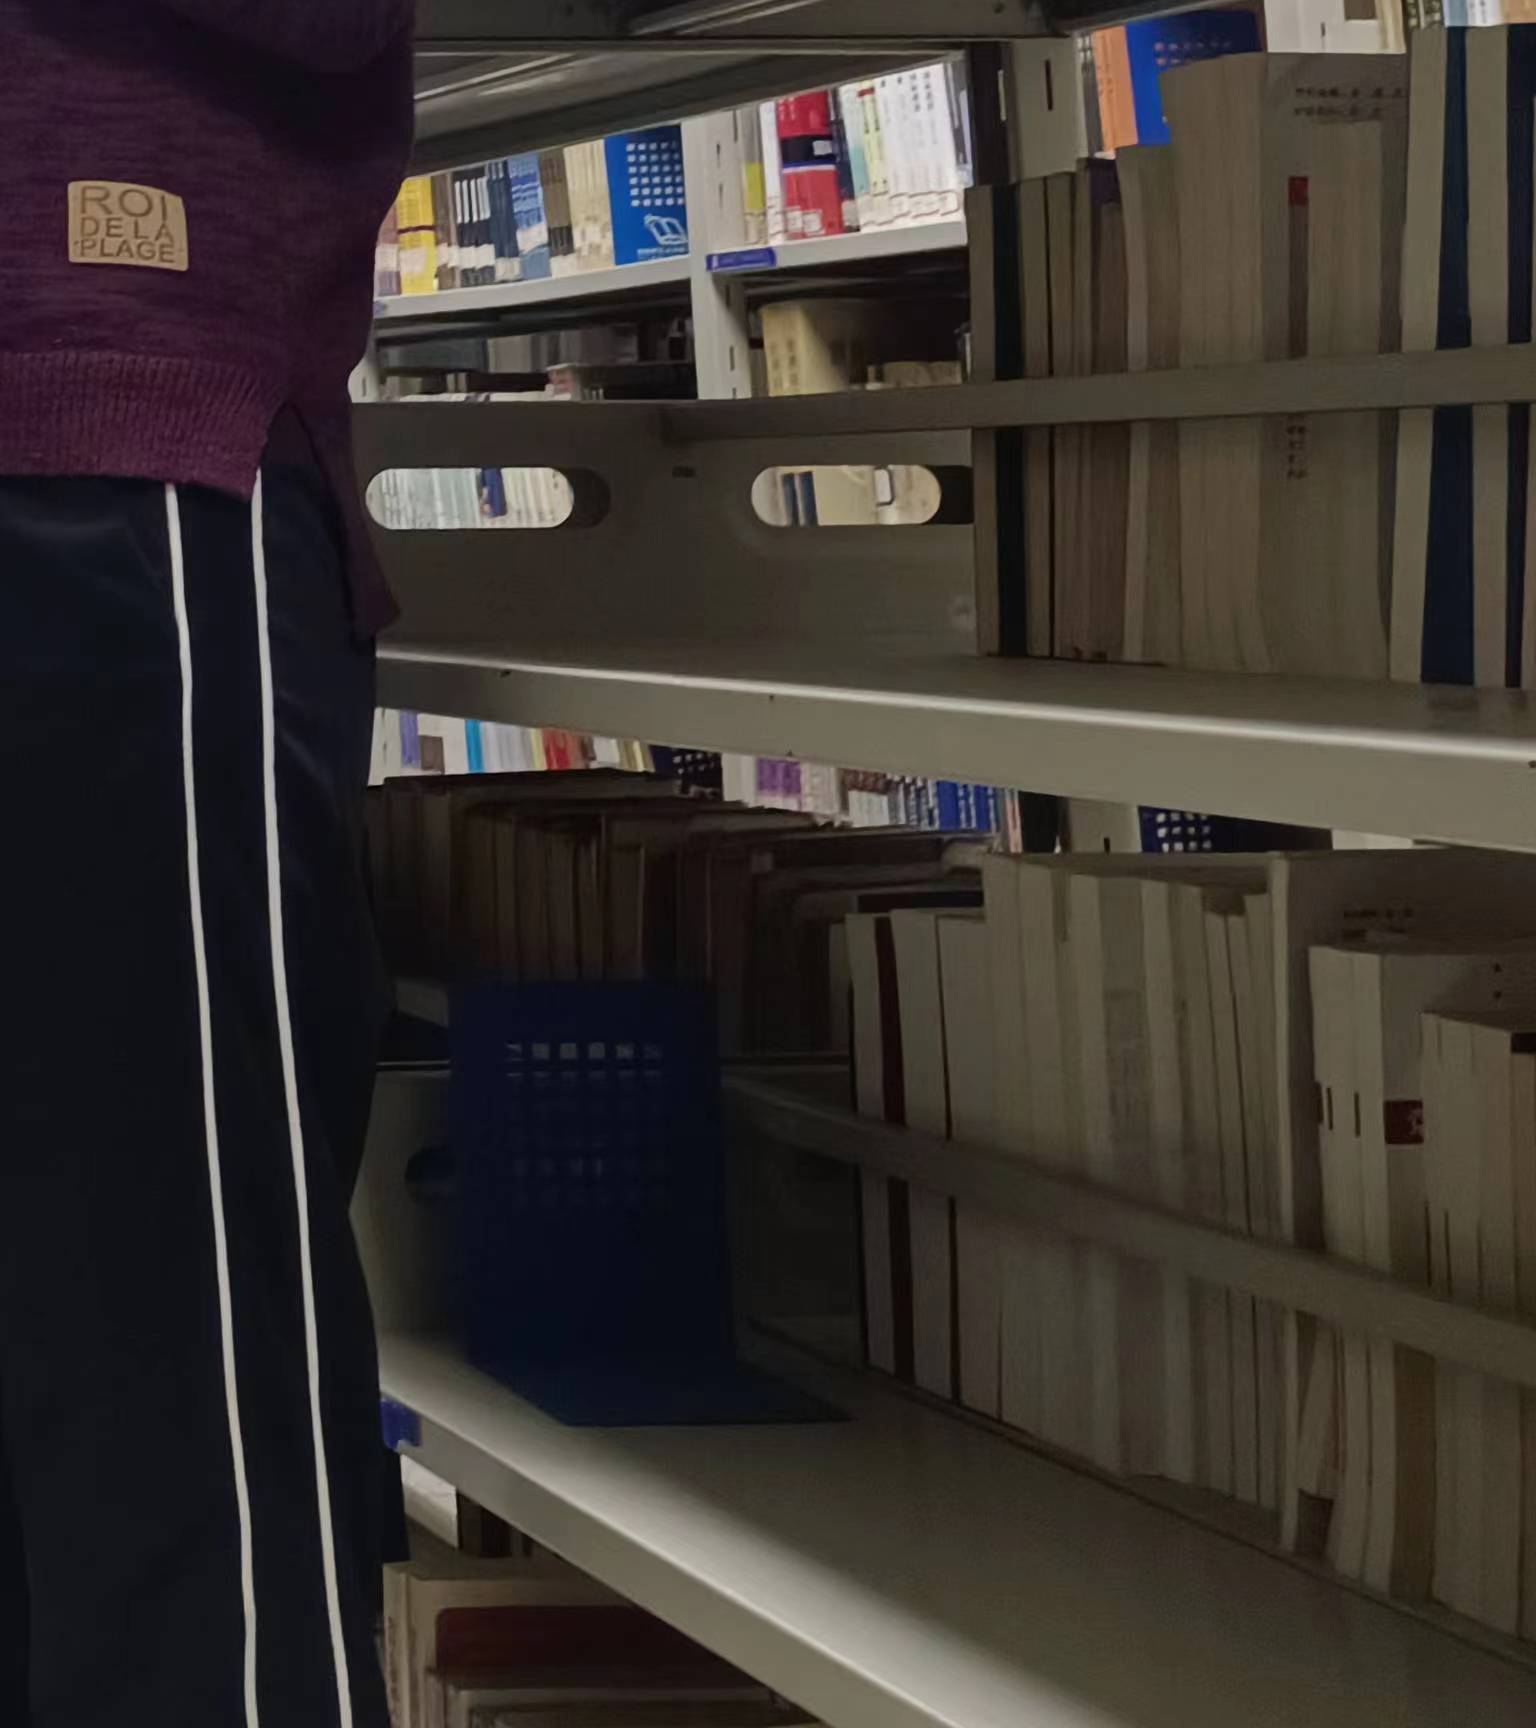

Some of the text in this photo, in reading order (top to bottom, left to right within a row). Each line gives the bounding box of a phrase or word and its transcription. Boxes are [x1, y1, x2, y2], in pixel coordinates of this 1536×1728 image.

[81, 186, 169, 221] ROI
[81, 218, 174, 242] DE LA
[79, 239, 175, 263] PLAGE
